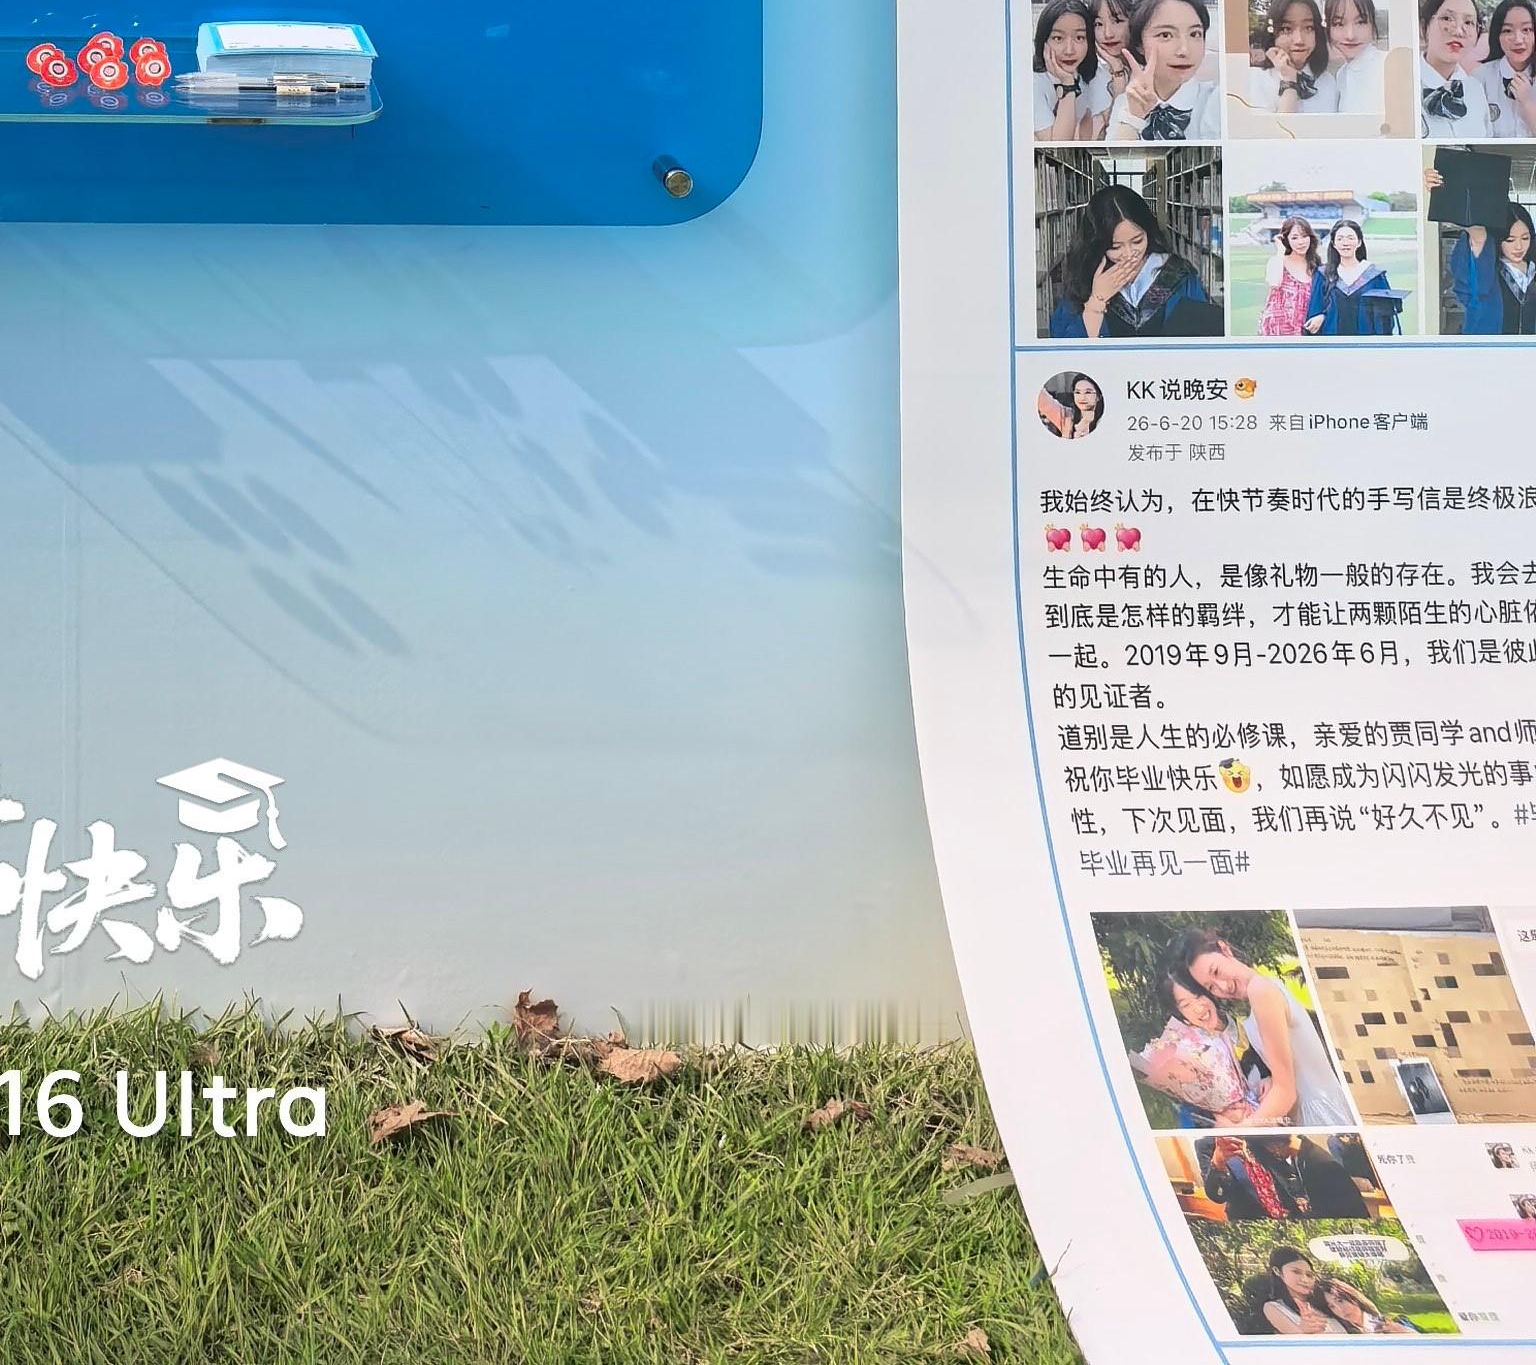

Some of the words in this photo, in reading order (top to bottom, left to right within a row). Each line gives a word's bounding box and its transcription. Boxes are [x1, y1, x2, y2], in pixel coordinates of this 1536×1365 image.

[1128, 416, 1202, 431] 26-6-20
[1210, 415, 1257, 430] 15:28
[1128, 444, 1182, 461] 发布于
[1190, 444, 1225, 461] 陕西
[1053, 683, 1164, 709] 的见证者。
[1064, 765, 1217, 792] 祝你毕业快乐
[1080, 850, 1250, 877] 毕业再见一面#
